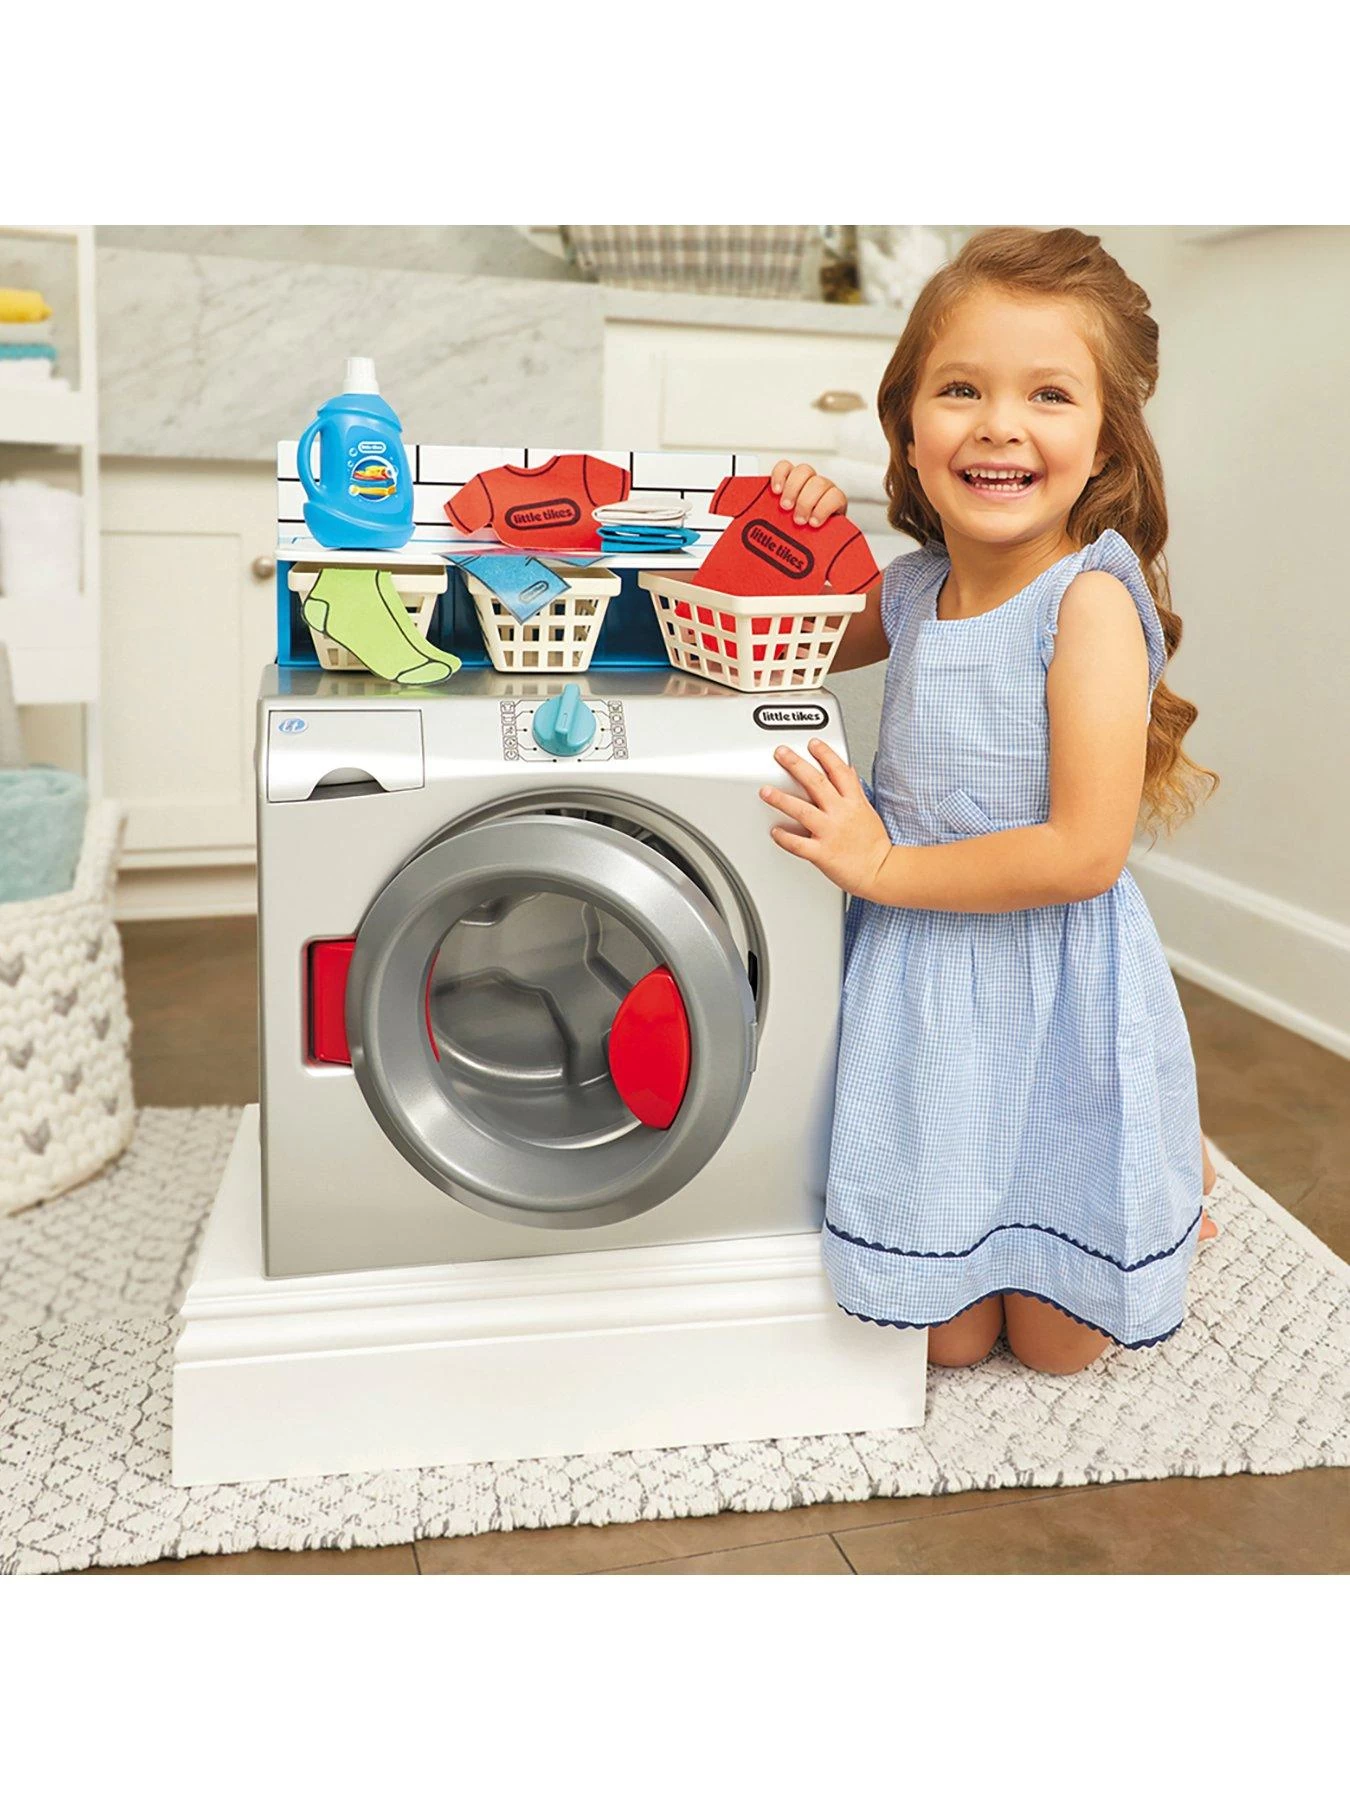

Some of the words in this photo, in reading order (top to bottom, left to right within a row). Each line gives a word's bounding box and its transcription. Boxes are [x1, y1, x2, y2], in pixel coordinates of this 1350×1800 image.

[513, 512, 542, 524] little
[543, 509, 573, 520] tikes
[750, 527, 777, 552] little
[775, 544, 804, 571] tikes
[762, 711, 791, 721] little
[791, 711, 821, 721] tikes
